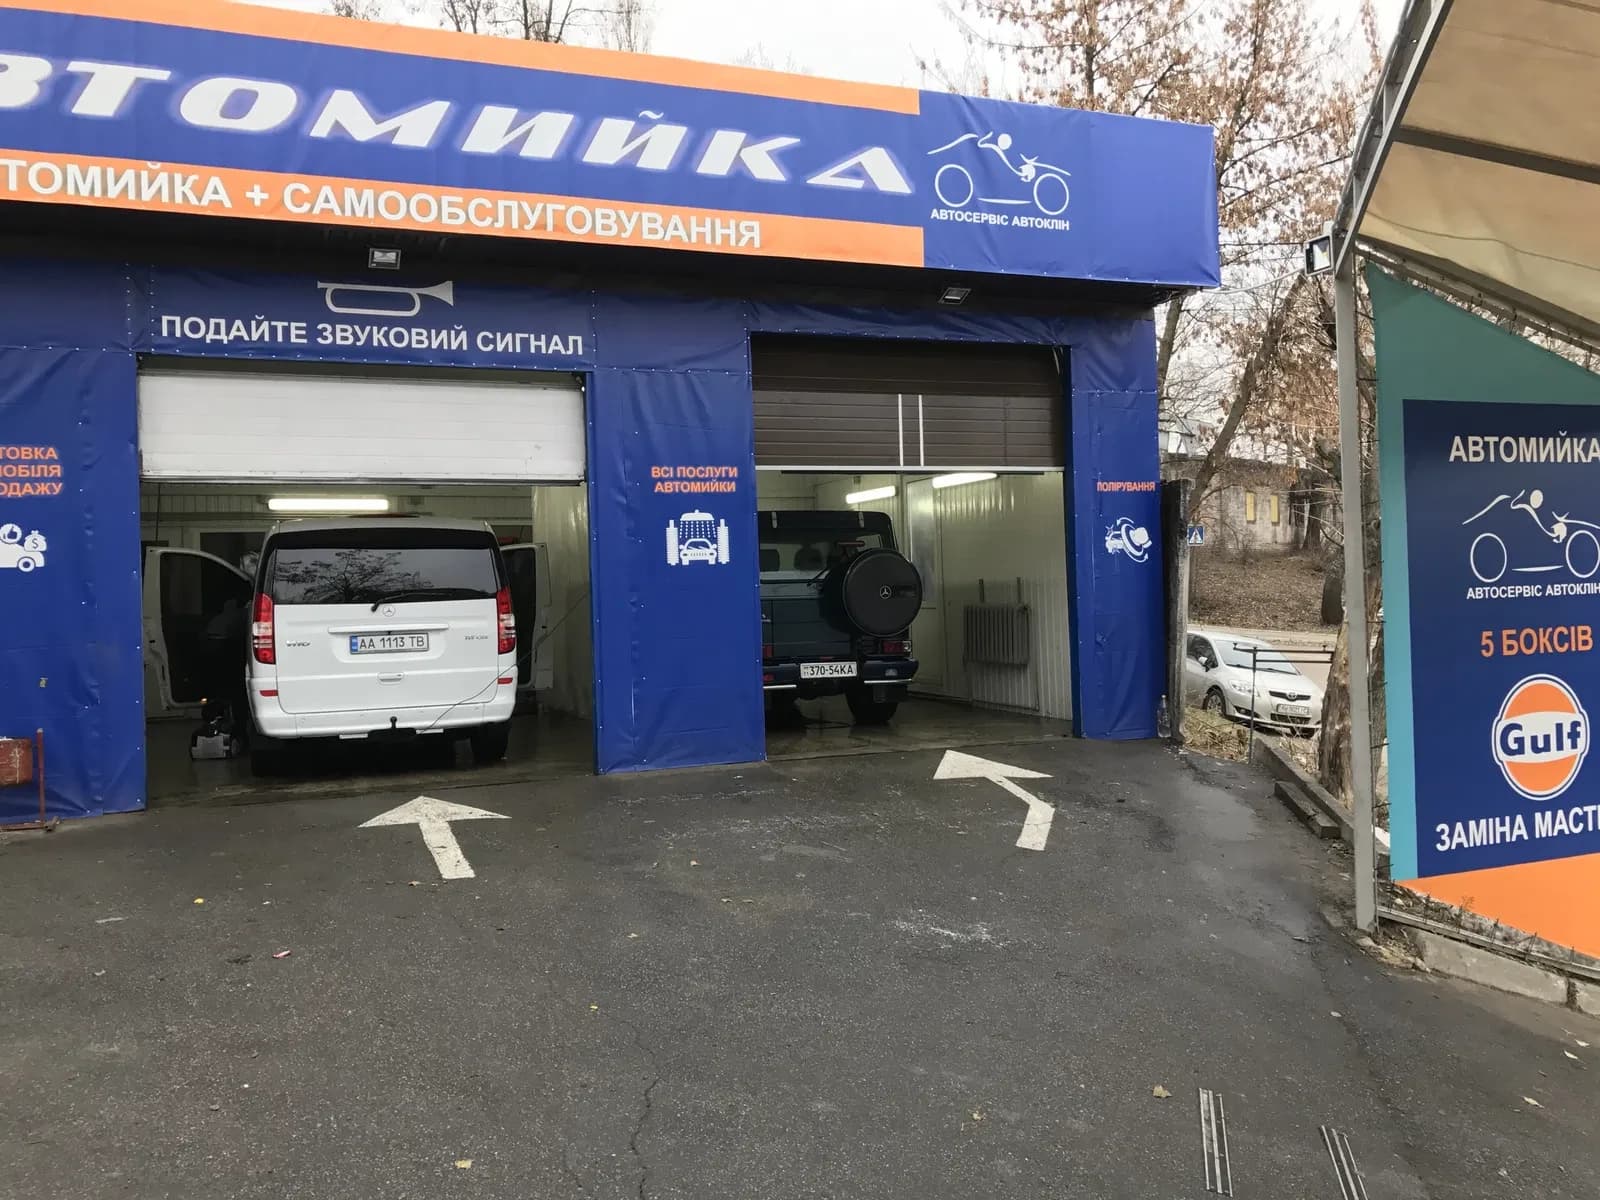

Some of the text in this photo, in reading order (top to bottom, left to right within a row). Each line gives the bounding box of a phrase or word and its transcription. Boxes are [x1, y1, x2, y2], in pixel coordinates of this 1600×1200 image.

[0, 158, 232, 209] ТОМИЙКА
[283, 182, 760, 248] САМООБСЛУГОВУВАННЯ
[930, 208, 1070, 231] АВТОСЕРВІС АВТОКЛІН
[161, 314, 584, 355] ПОДАЙТЕ ЗВУКОВИЙ СИГНАЛ
[1449, 430, 1600, 463] АВТОМИЙКА
[0, 464, 62, 478] ОБІЛЯ
[651, 466, 738, 478] ВСІ ПОСЛУГИ
[0, 482, 63, 498] ОДАЖУ
[654, 478, 737, 493] АВТОМИЙКИ
[1096, 481, 1156, 492] ПОЛІРУВАННЯ
[1466, 582, 1600, 600] АВТОСЕРВІС АВТОКЛІН
[380, 637, 405, 649] 1113
[1480, 624, 1593, 658] 5 БОКСІВ
[1500, 720, 1582, 757] Gulf
[1435, 804, 1600, 852] ЗАМІНА МАСТ
